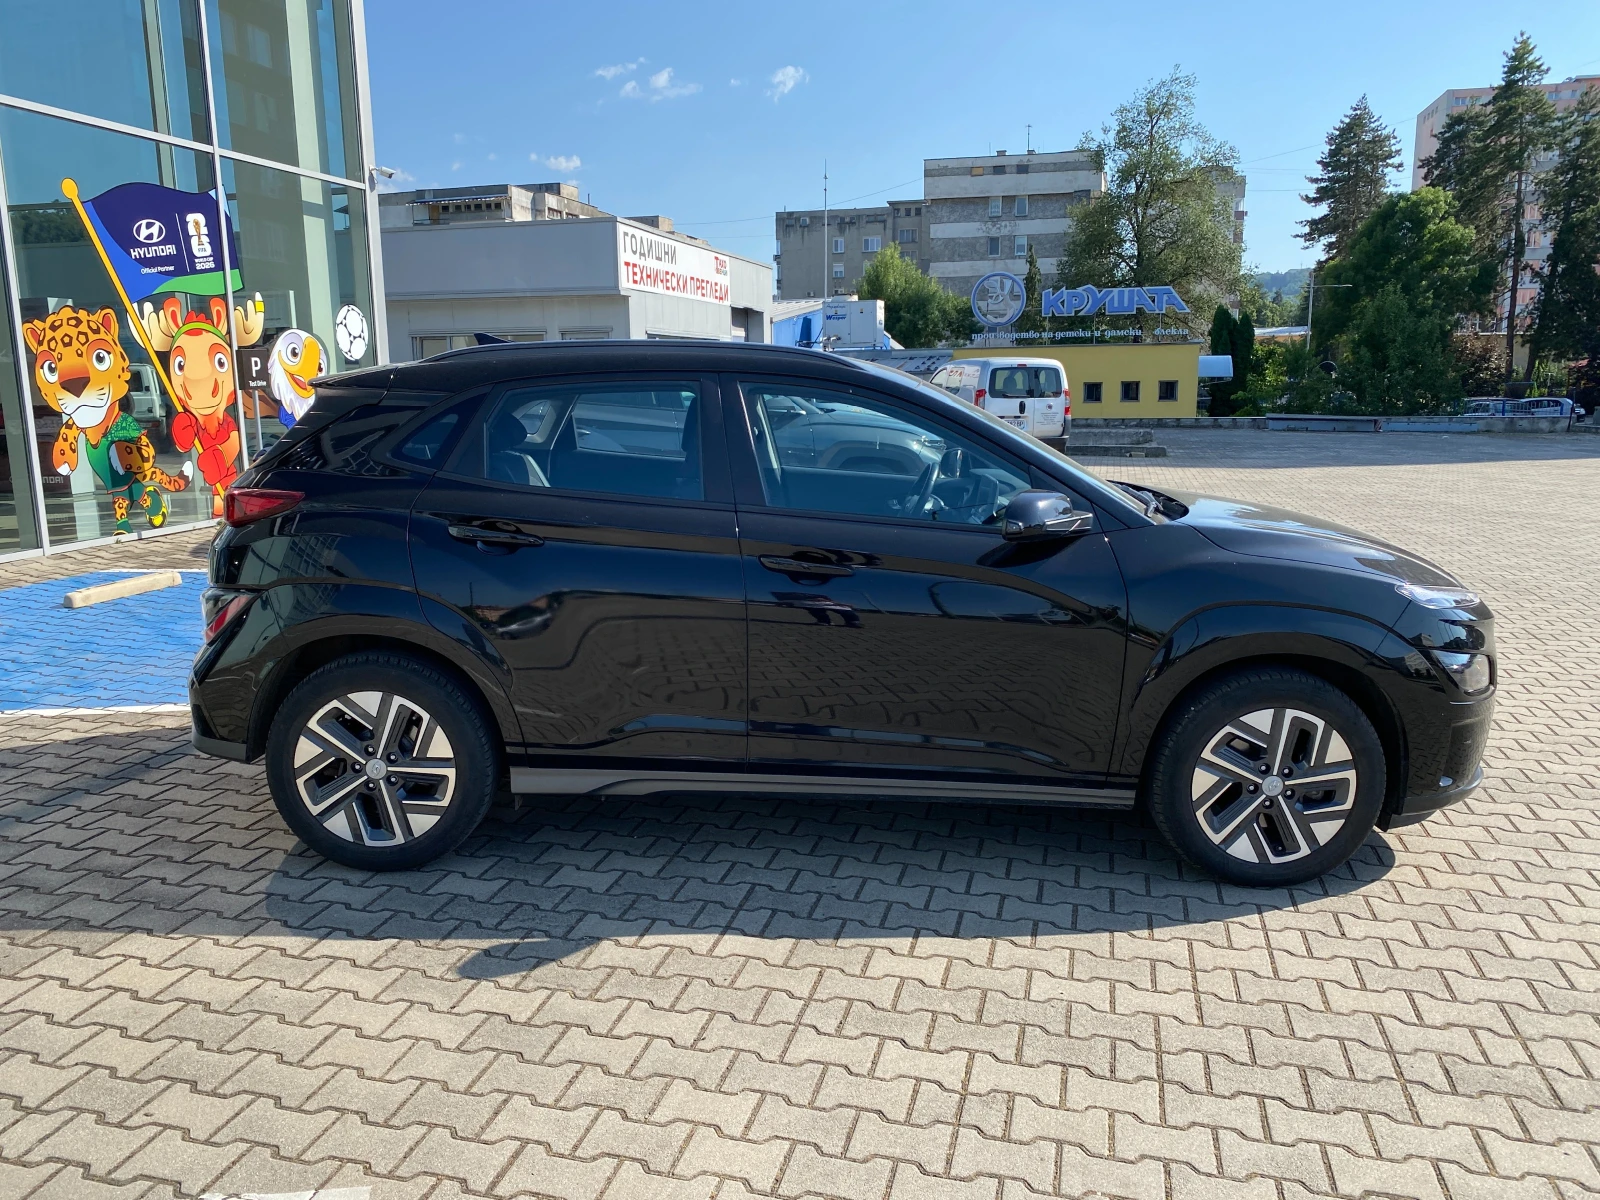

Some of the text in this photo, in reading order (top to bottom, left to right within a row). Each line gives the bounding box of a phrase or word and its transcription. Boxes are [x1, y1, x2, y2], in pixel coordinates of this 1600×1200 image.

[130, 244, 177, 259] HYUNDAI
[623, 231, 677, 266] ГОДИШНИ
[140, 267, 158, 275] Official
[195, 262, 215, 270] 2026
[624, 261, 688, 294] ТЕХНИЧЕСКИ
[690, 276, 729, 304] ПРЕГЛЕДИ
[1042, 284, 1191, 317] КРУШАТА
[250, 356, 261, 378] P
